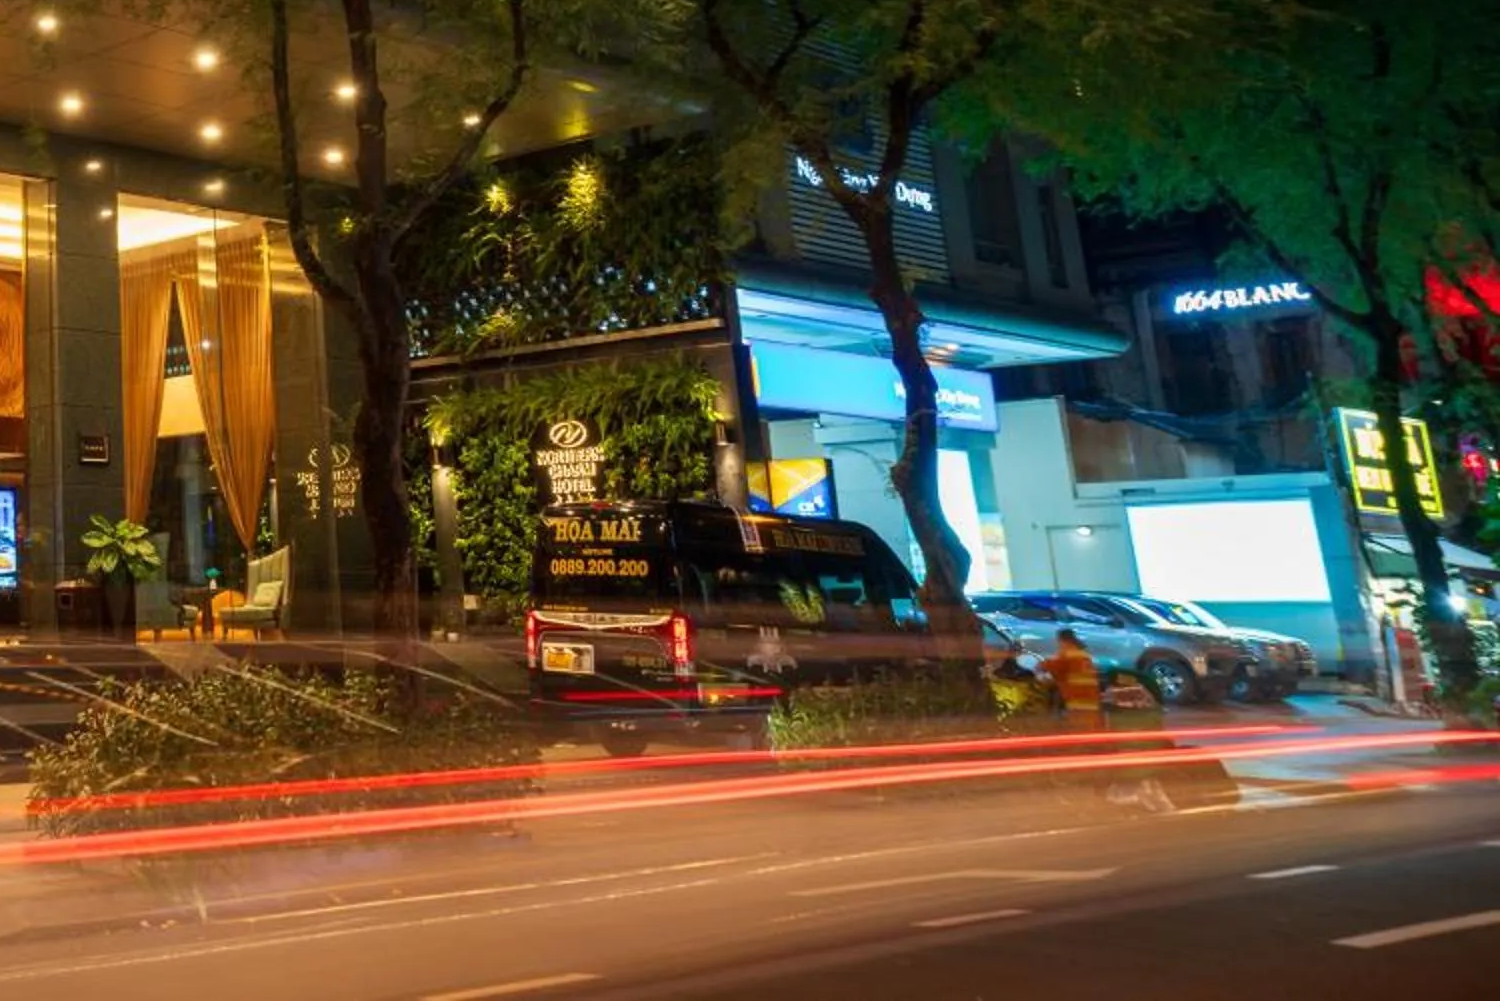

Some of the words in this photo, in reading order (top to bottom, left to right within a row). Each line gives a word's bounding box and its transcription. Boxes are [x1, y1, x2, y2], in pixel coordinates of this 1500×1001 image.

[1174, 290, 1222, 314] 1664
[1223, 282, 1311, 308] BLANC
[551, 479, 597, 494] HOTEL
[550, 559, 650, 576] 0889.200.200
